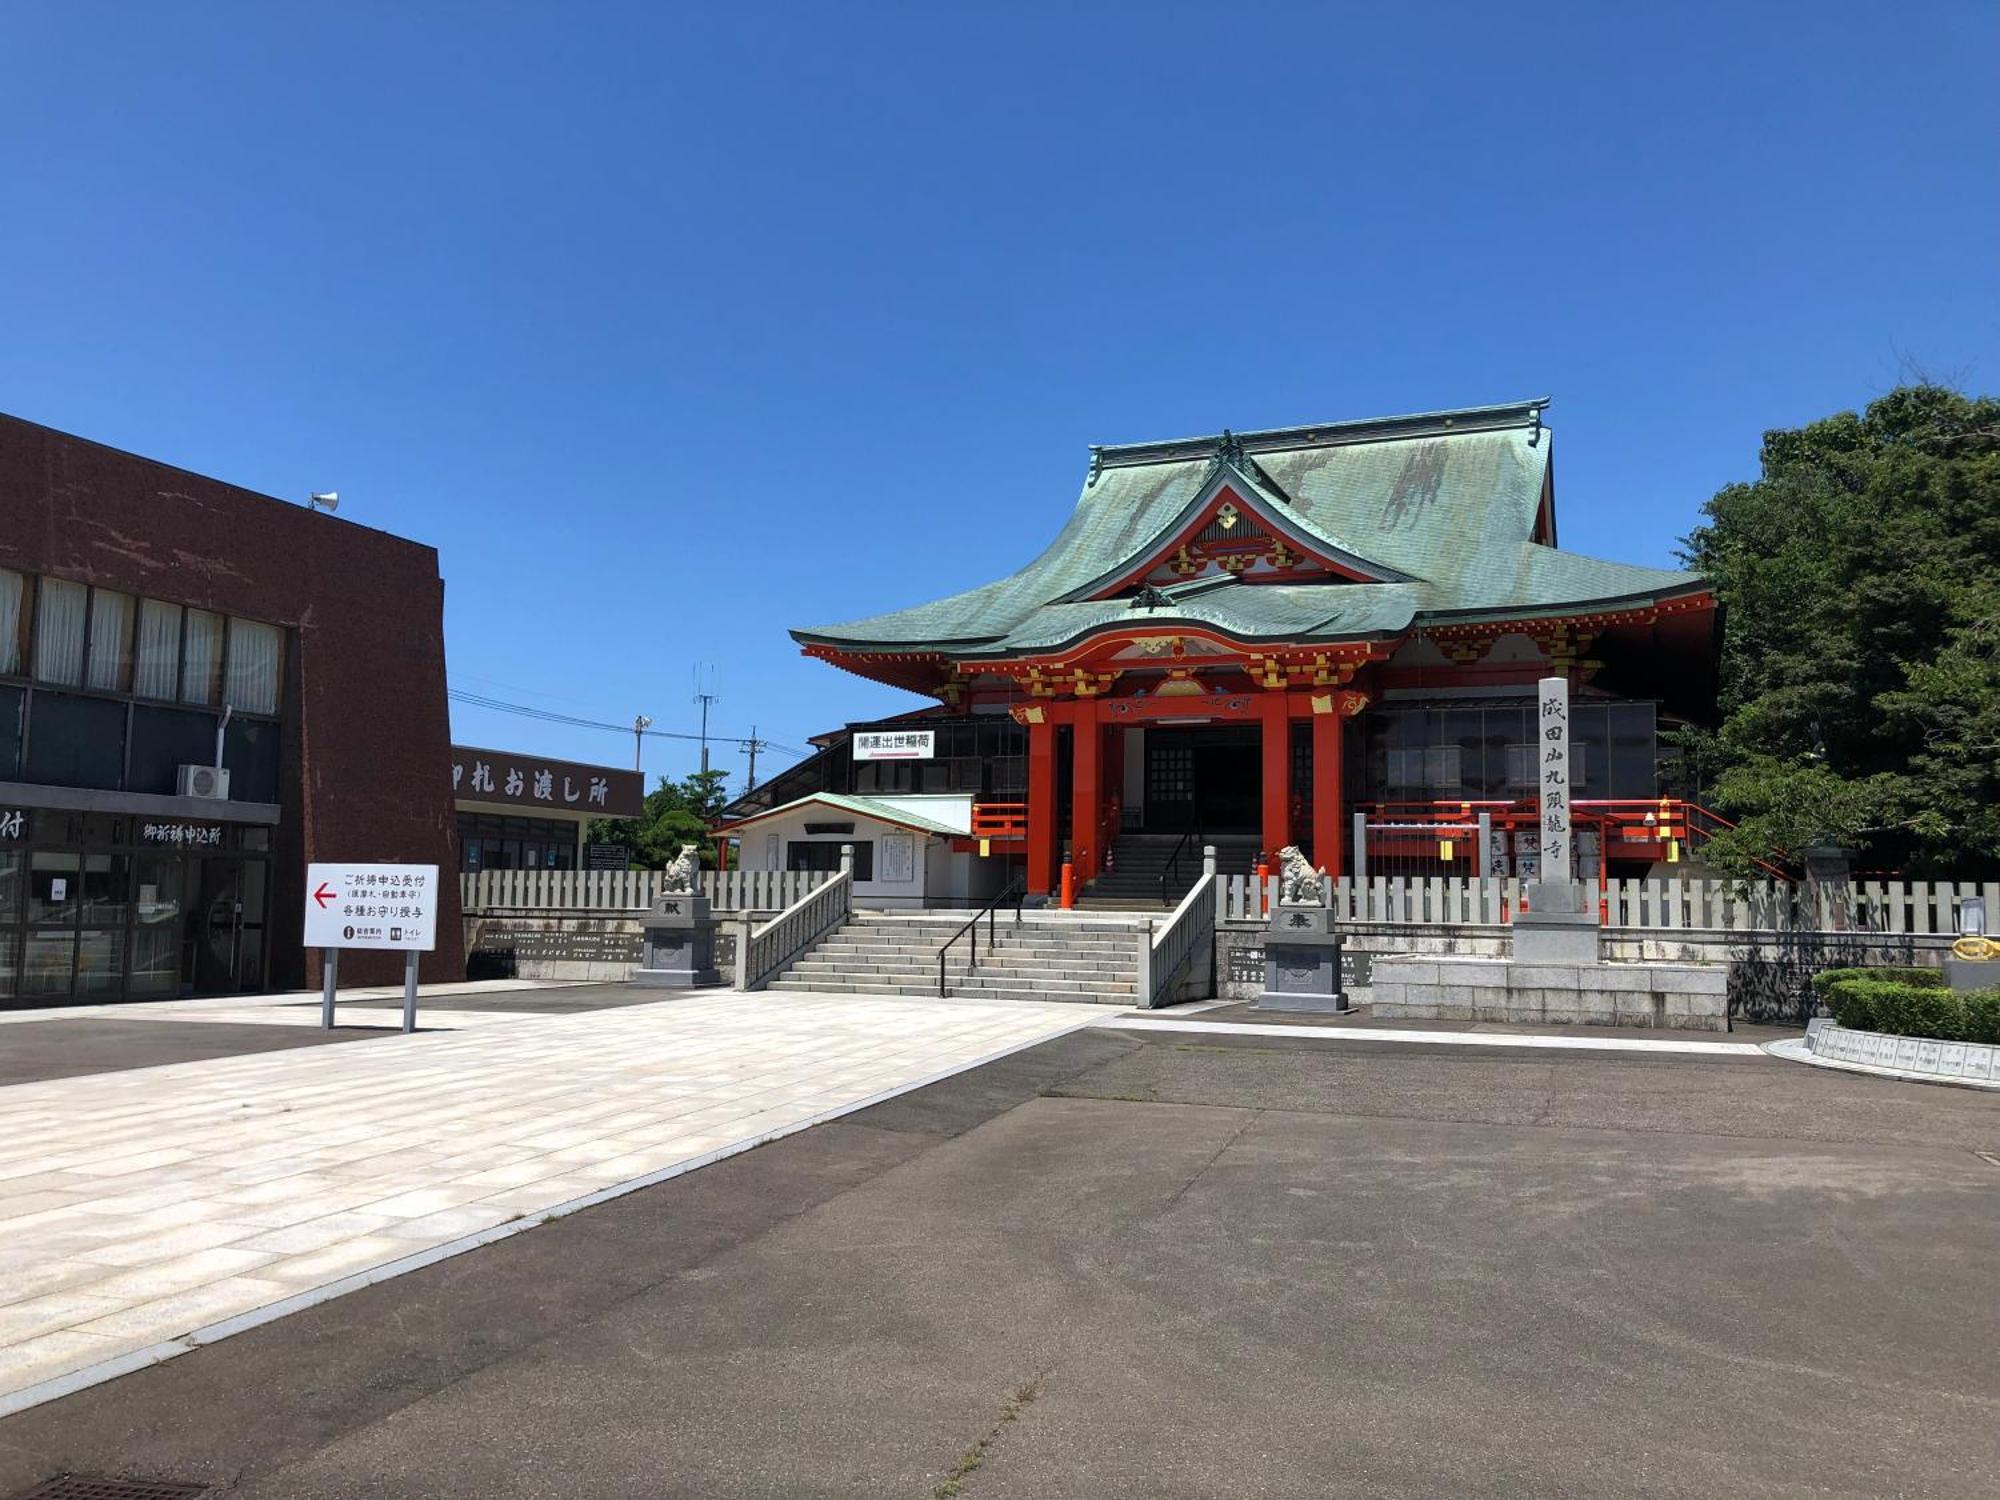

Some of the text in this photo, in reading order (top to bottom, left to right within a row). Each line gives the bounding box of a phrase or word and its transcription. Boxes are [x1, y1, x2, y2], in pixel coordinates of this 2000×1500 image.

[1542, 698, 1566, 859] 成田山九頭龍寺
[343, 904, 423, 918] 各種お守り授与
[404, 928, 422, 936] トイレ
